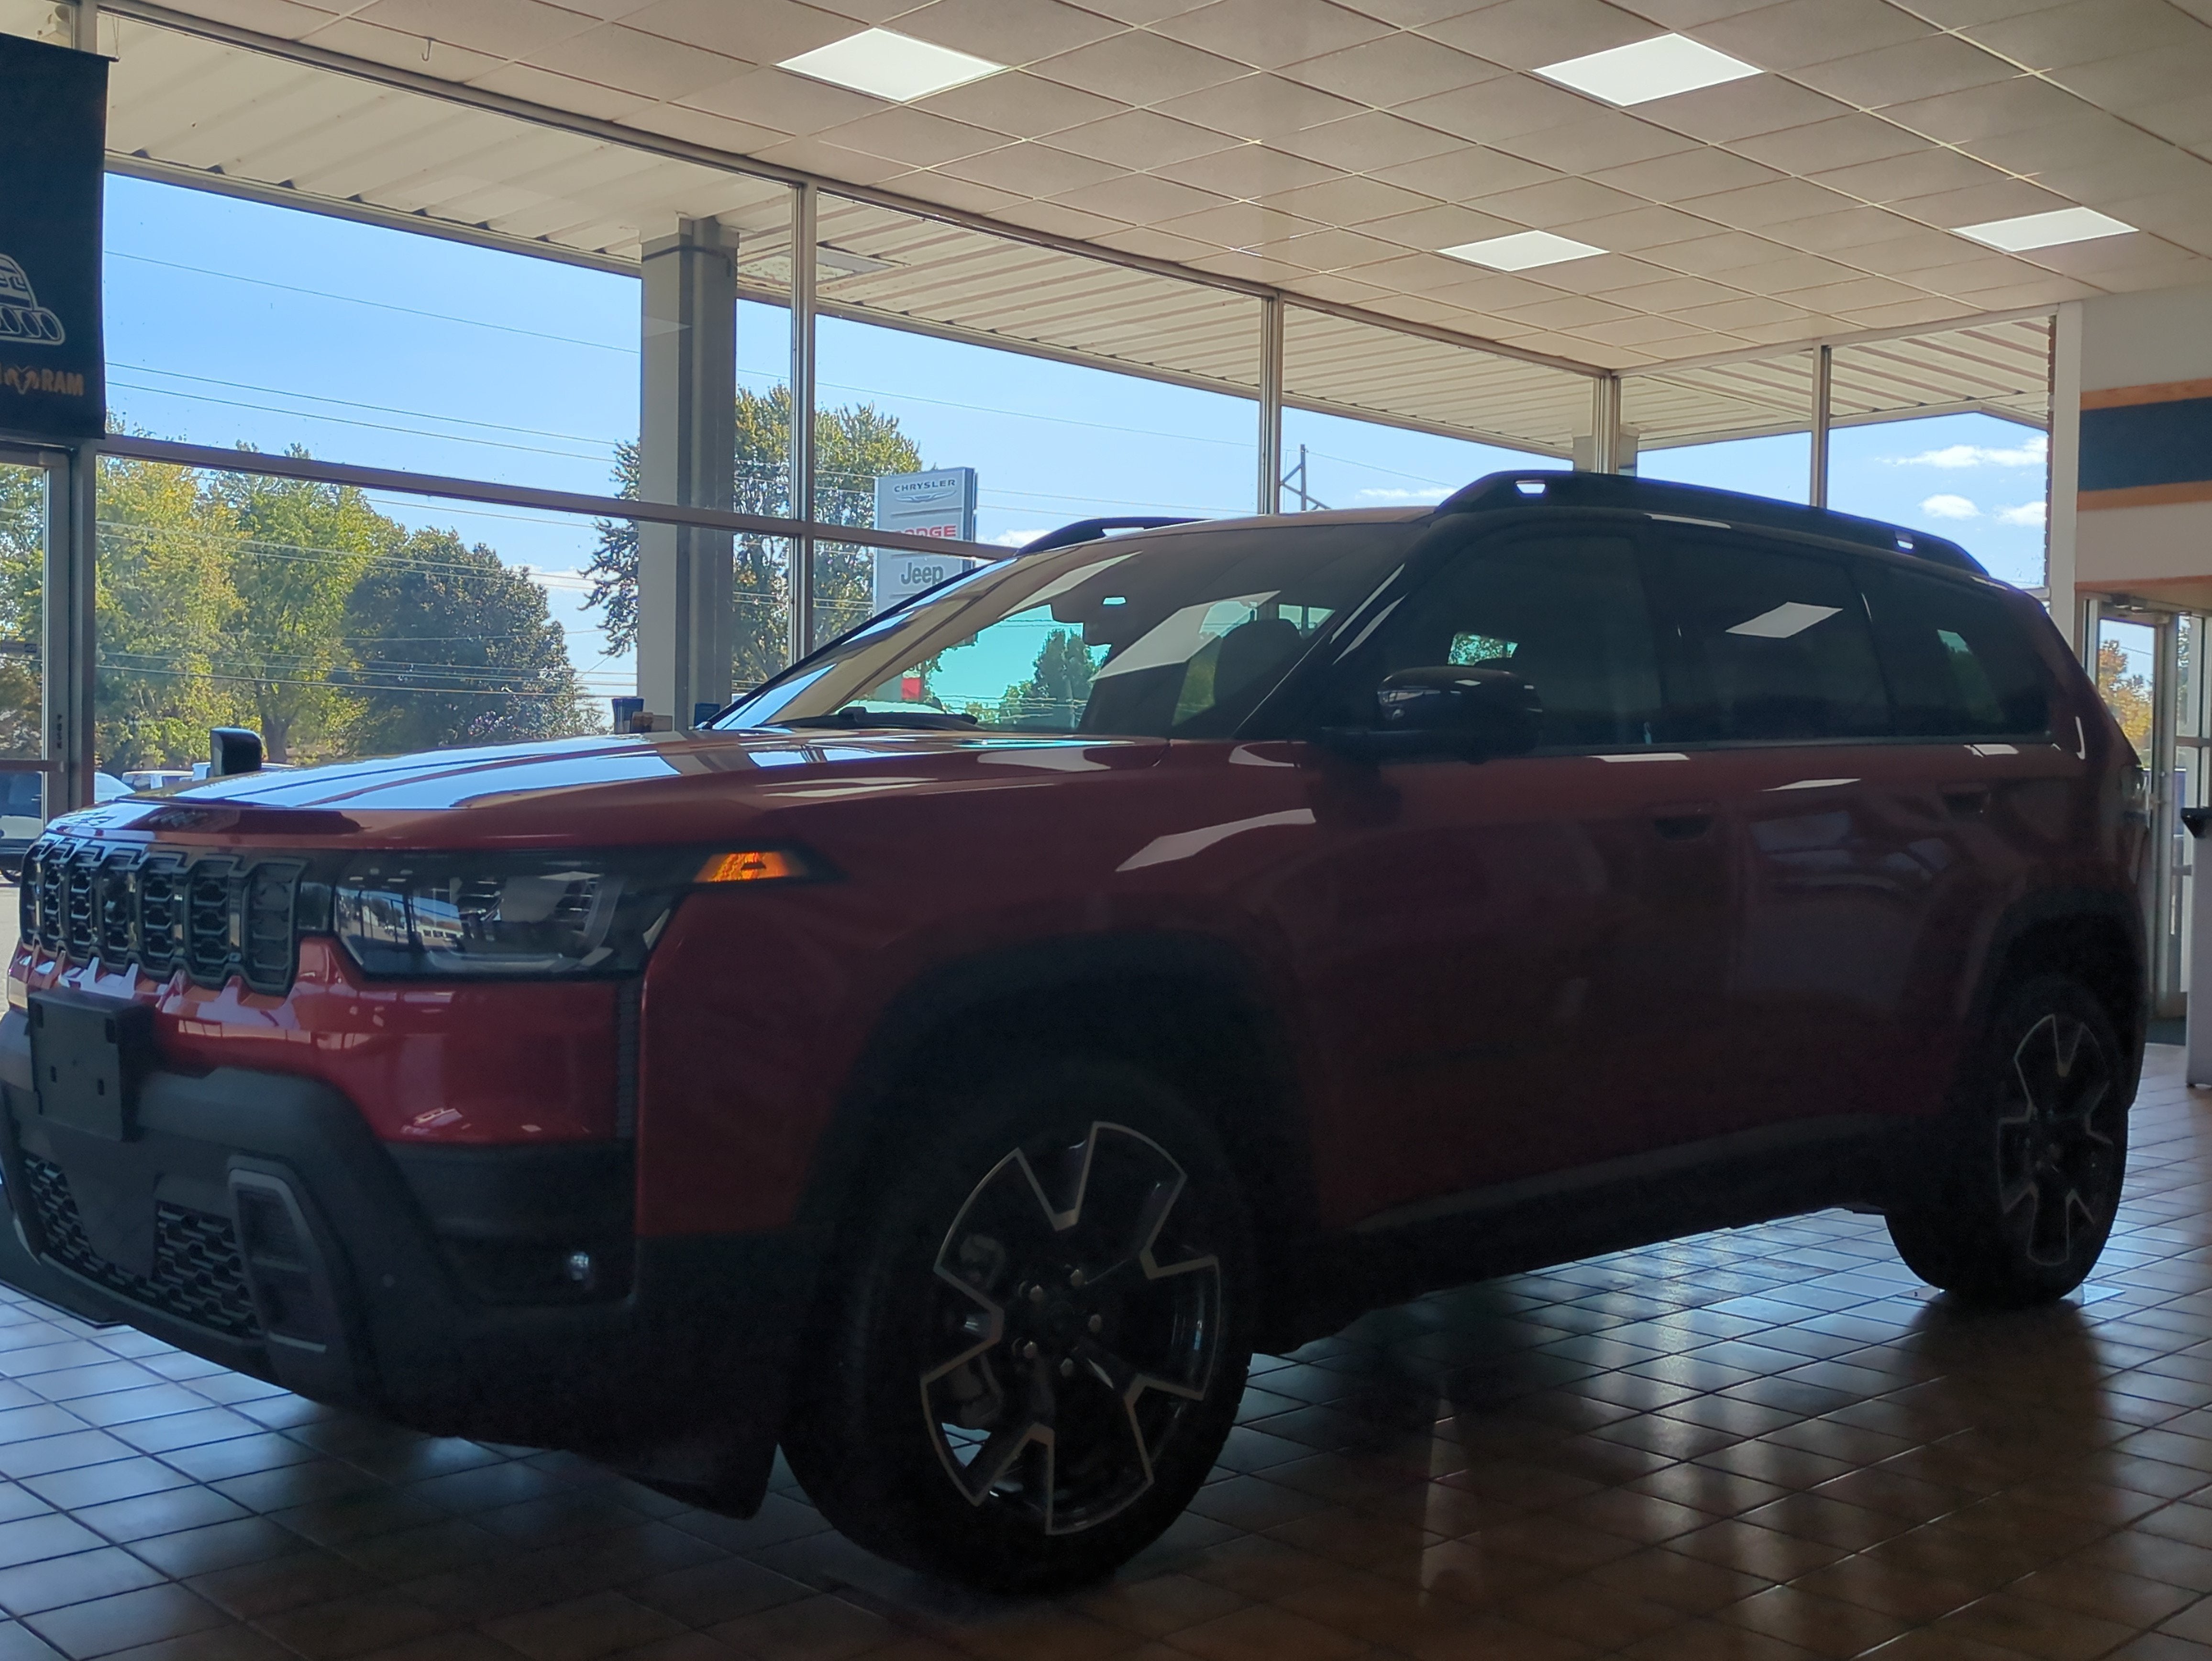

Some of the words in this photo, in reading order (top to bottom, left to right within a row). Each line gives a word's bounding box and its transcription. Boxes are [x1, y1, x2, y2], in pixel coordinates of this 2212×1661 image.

[41, 368, 84, 396] RAM
[894, 479, 956, 492] CHRYSLER
[901, 562, 943, 586] Jeep
